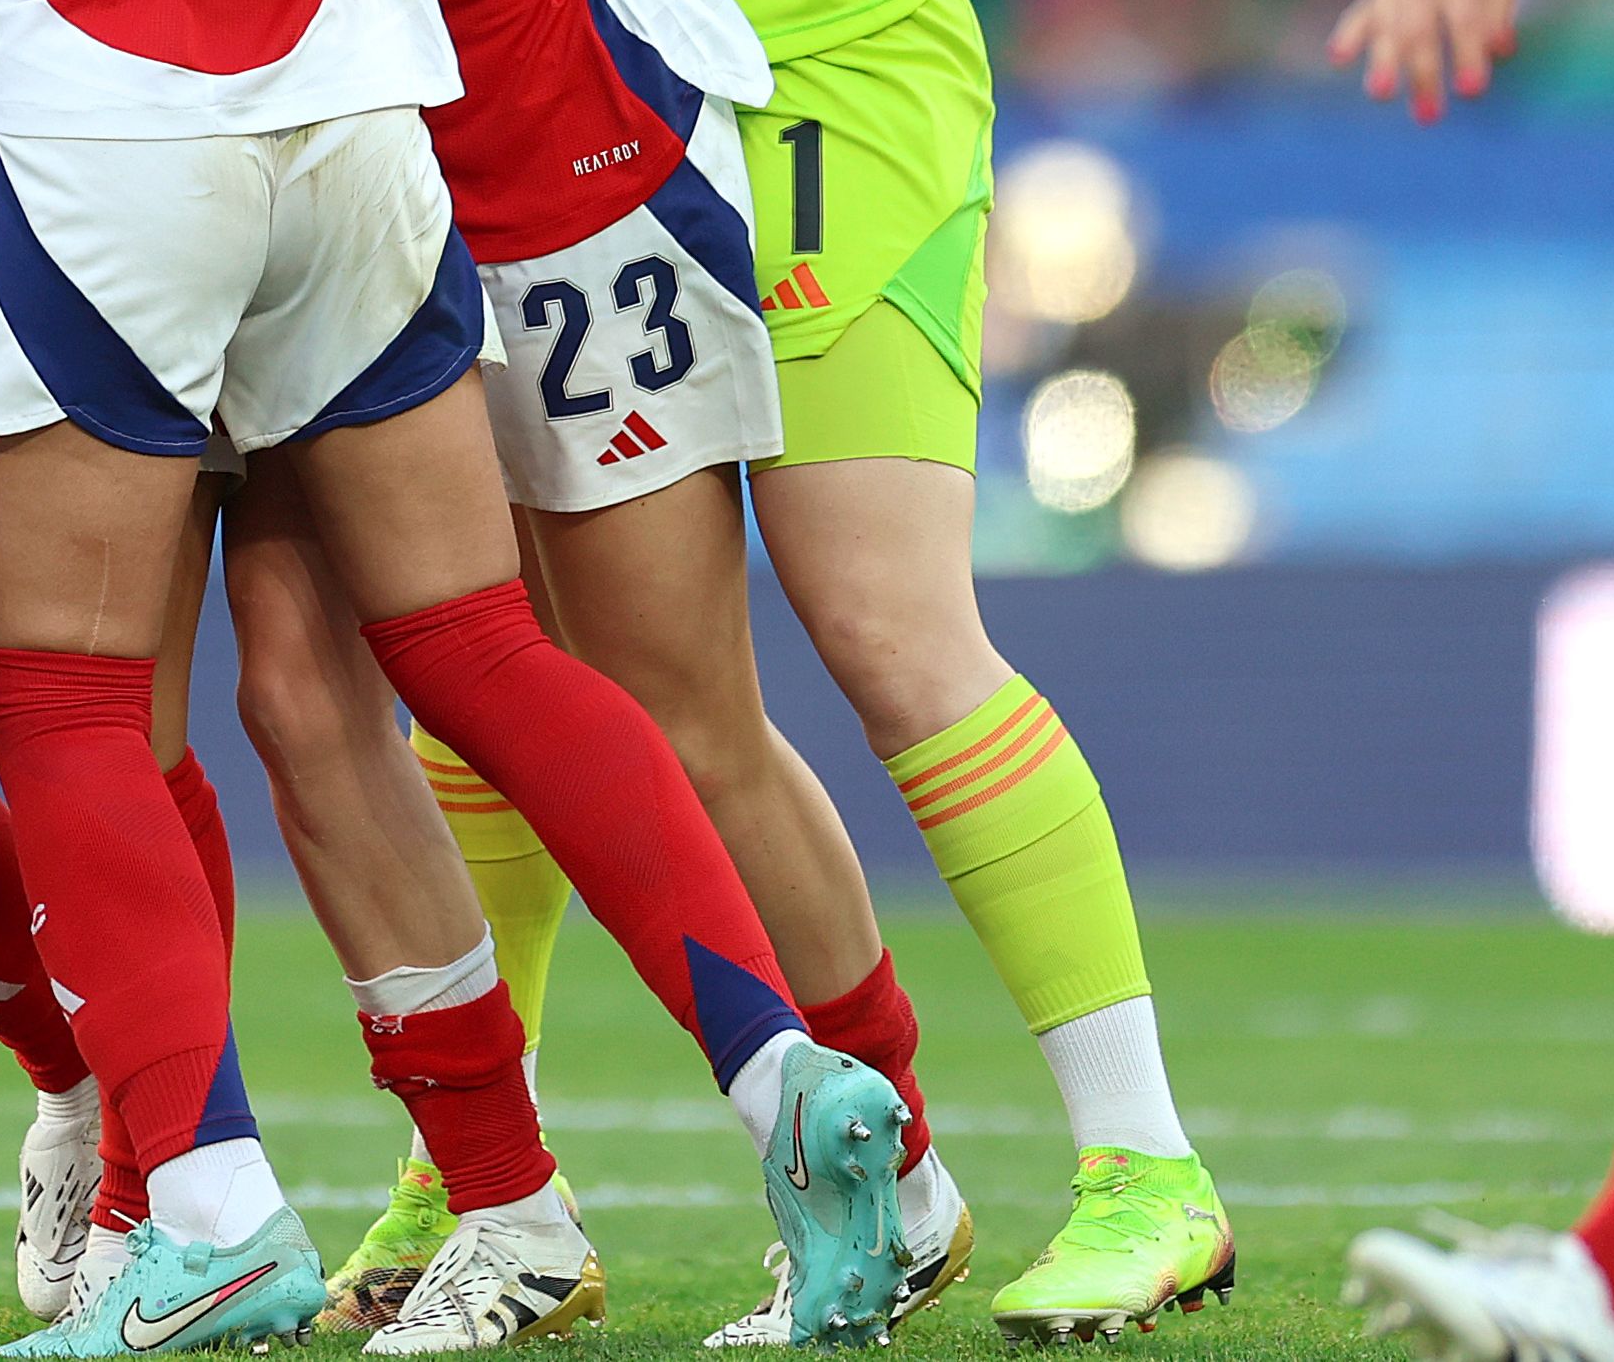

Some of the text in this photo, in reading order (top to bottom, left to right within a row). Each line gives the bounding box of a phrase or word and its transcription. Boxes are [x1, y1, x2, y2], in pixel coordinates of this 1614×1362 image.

[572, 139, 641, 177] HEAT.RDY
[778, 119, 824, 255] 1
[518, 250, 698, 423] 23
